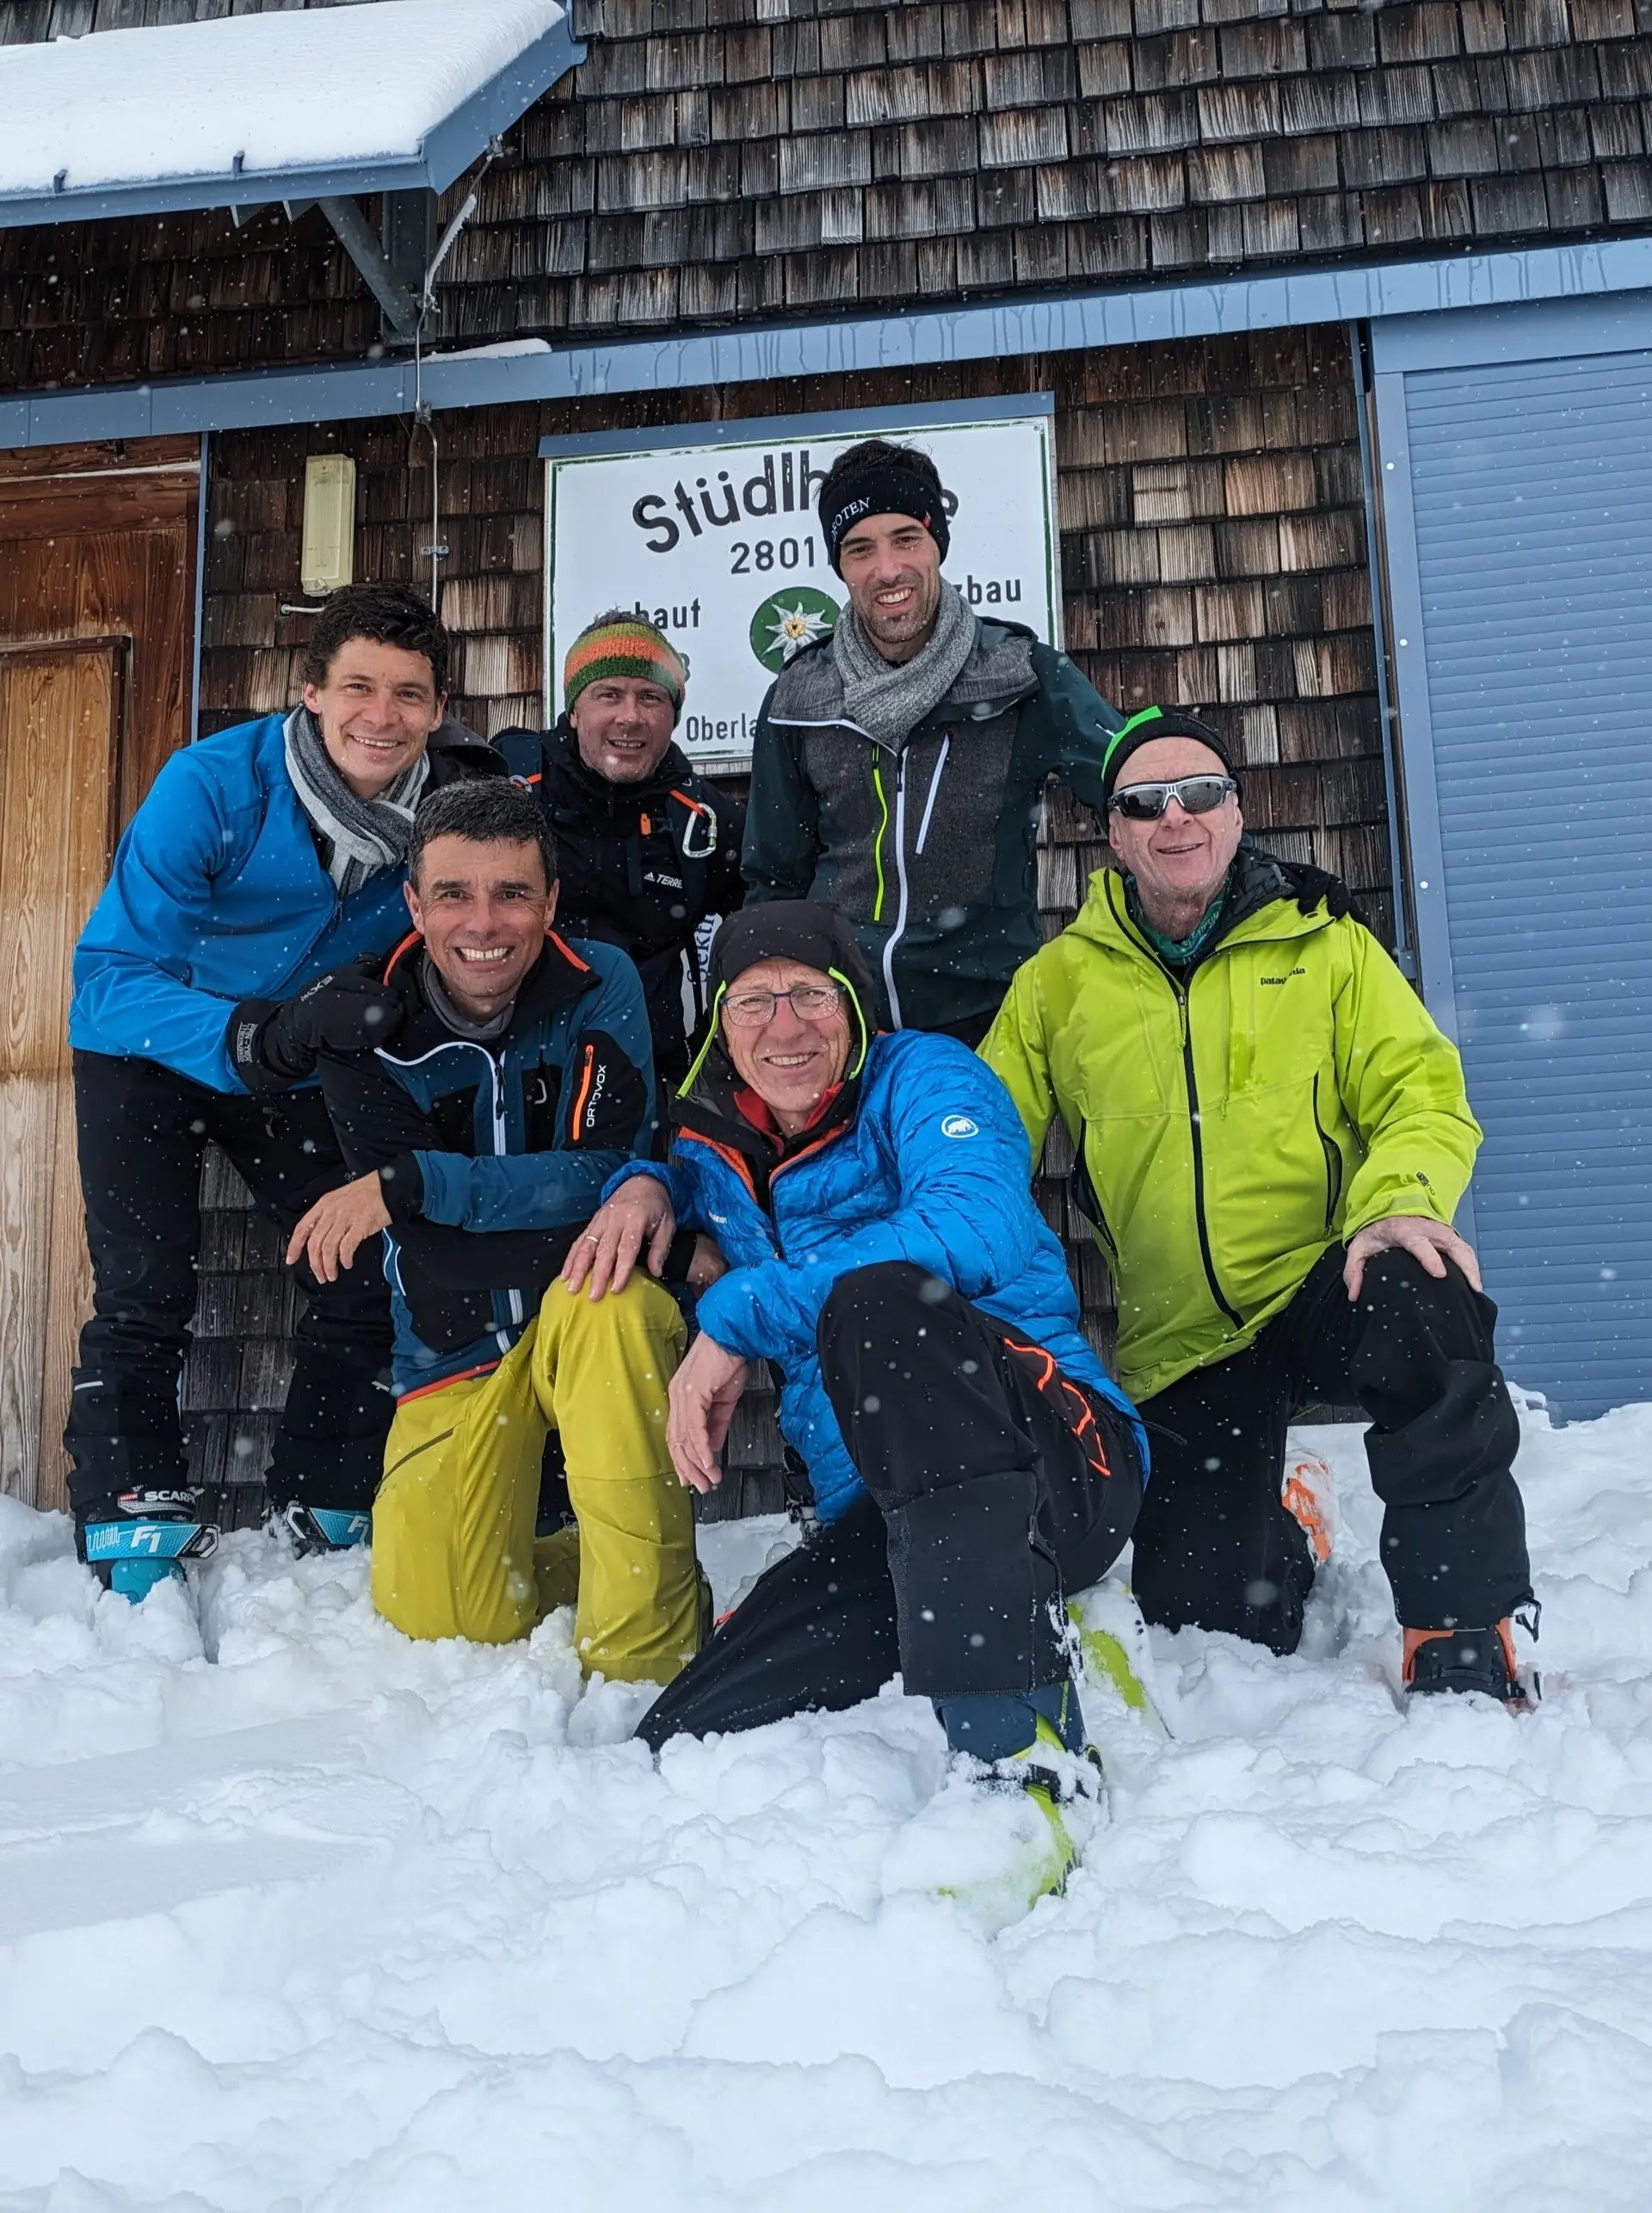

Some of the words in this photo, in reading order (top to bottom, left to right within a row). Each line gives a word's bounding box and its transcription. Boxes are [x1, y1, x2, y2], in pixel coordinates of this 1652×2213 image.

[632, 450, 959, 553] Stüdlhe
[730, 535, 815, 575] 2801
[686, 712, 758, 743] Oberla
[656, 872, 683, 890] TERRE
[586, 1063, 607, 1128] ORTOVOX
[130, 1525, 162, 1554] F1
